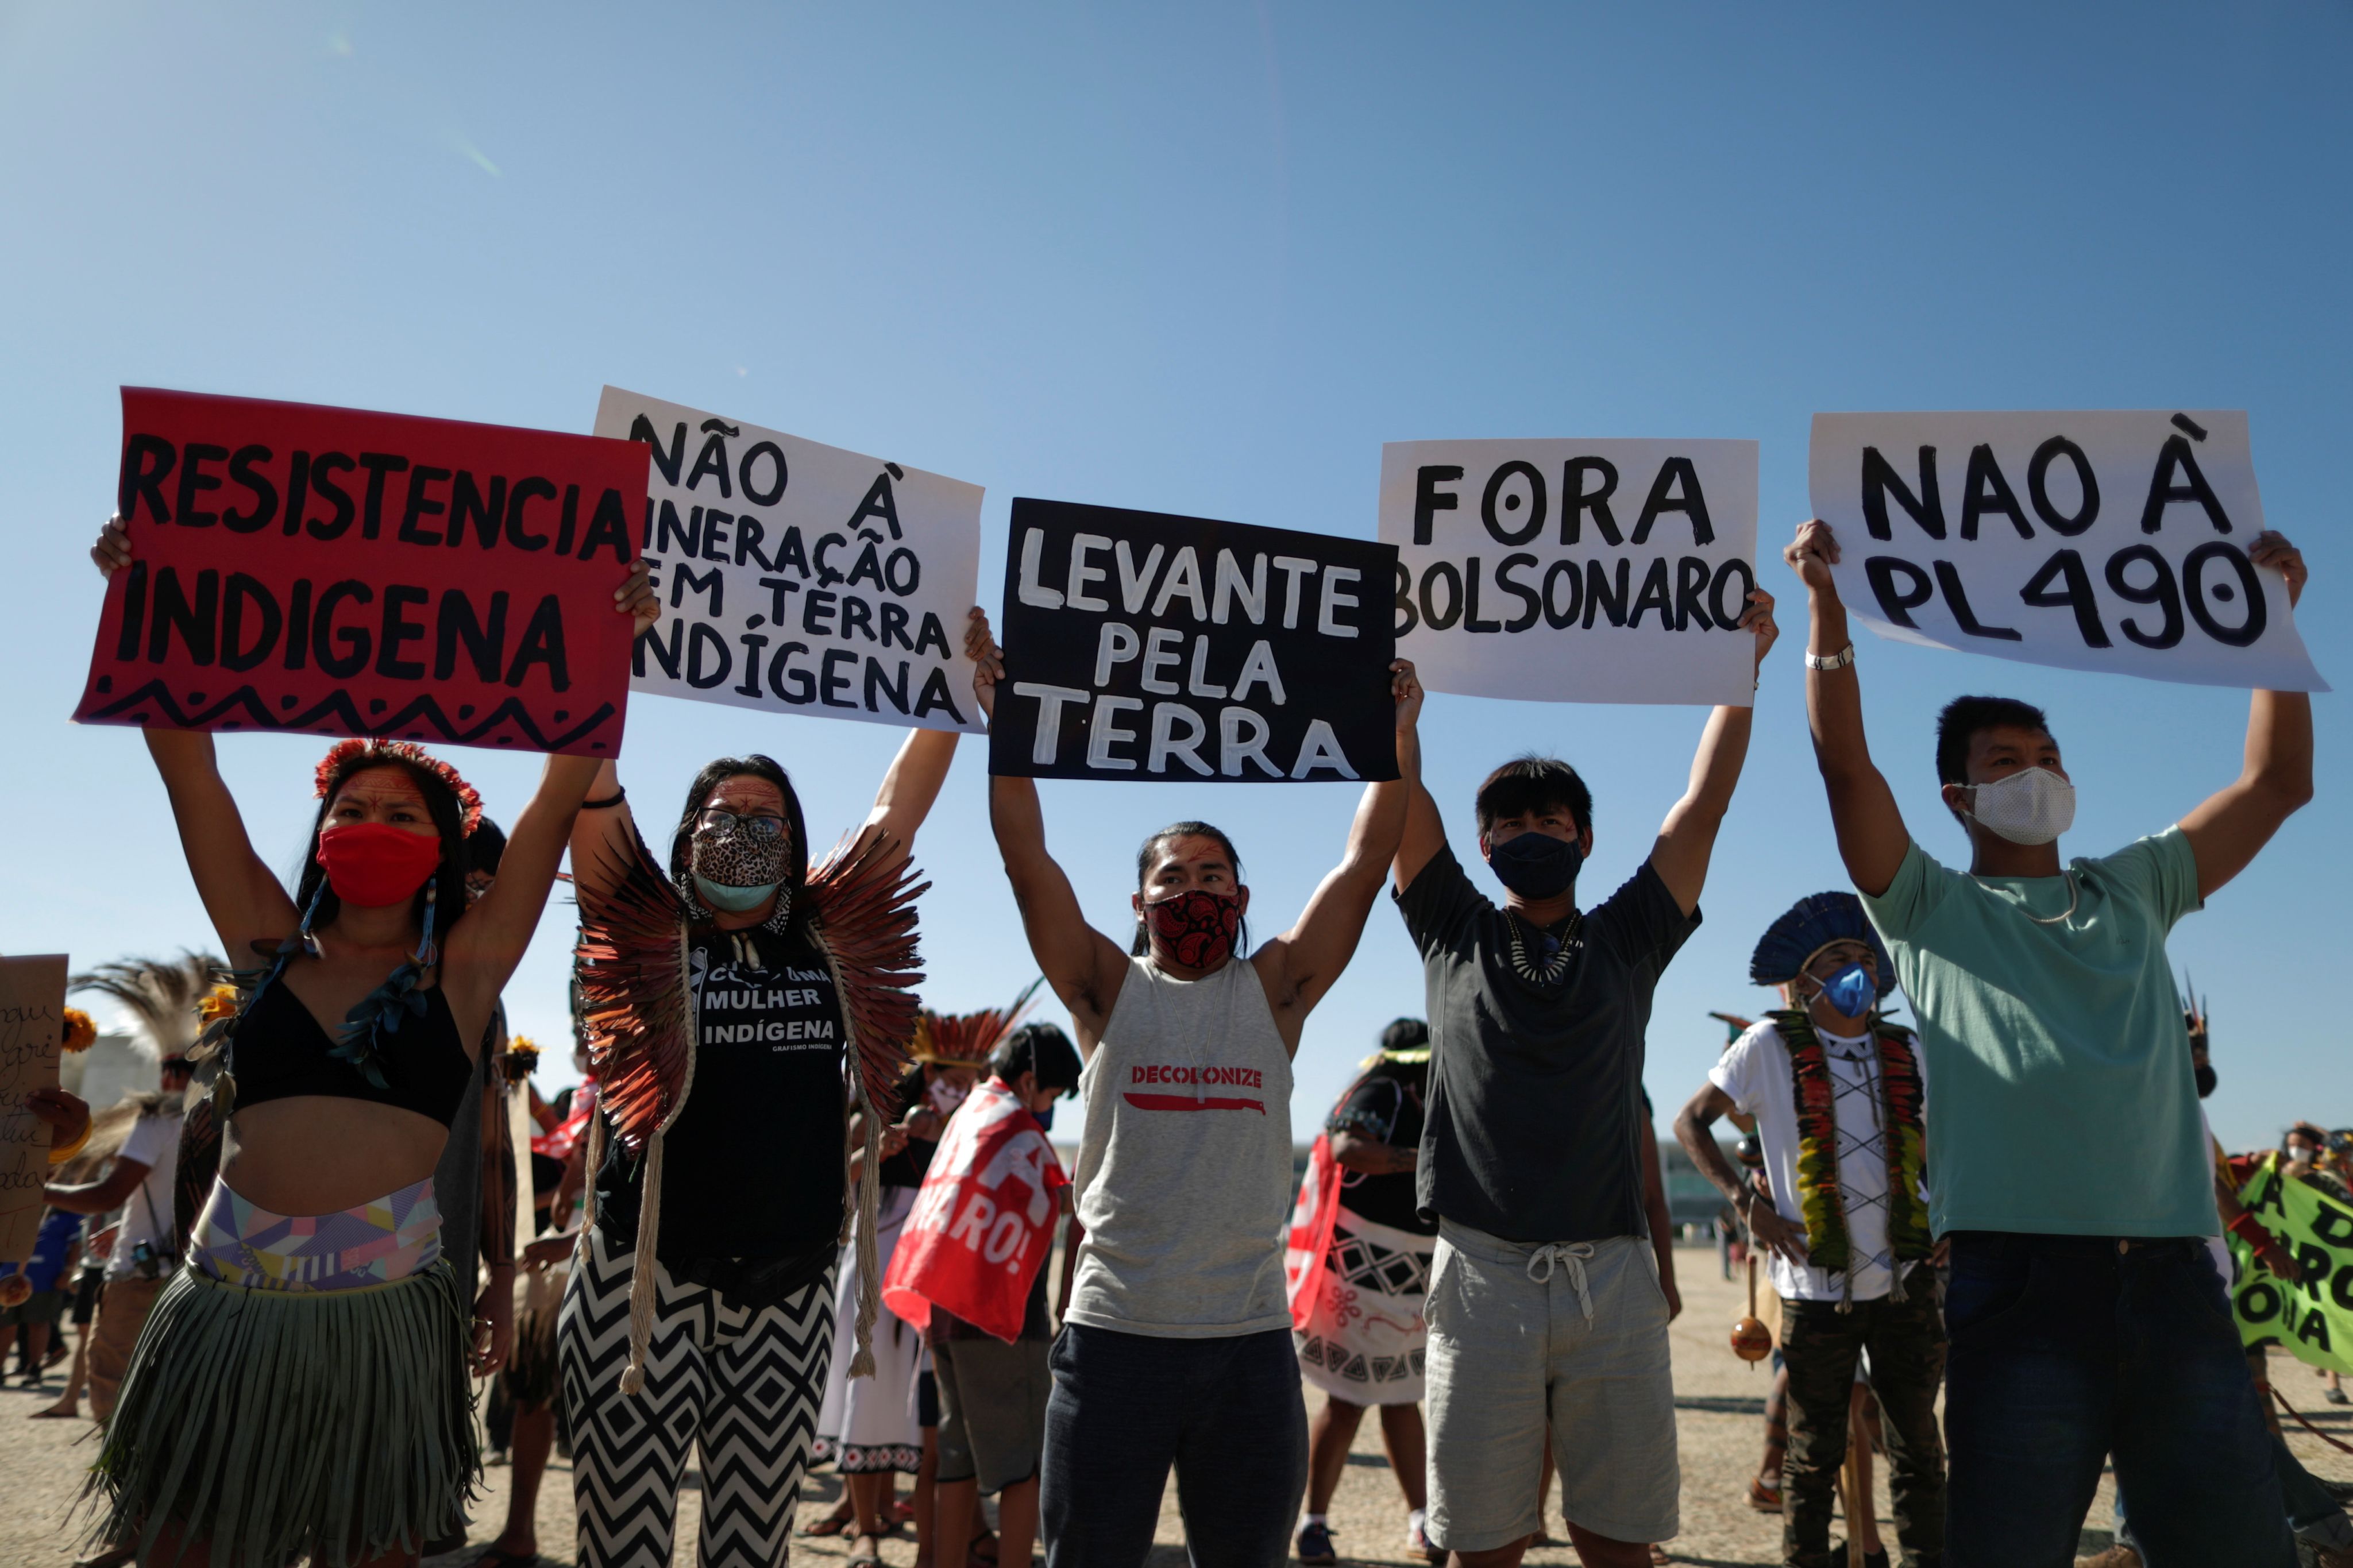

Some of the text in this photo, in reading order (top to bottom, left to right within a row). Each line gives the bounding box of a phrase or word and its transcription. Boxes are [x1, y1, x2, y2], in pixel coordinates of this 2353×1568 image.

[121, 433, 632, 565] RESISTENCIA
[629, 413, 788, 507] NÃO
[1413, 456, 1715, 546] FORA
[1861, 412, 2234, 541] NAO À
[642, 496, 920, 597] INERAÇÃO
[1018, 527, 1361, 638] LEVANTE
[115, 559, 571, 693] INDIGENA
[759, 577, 952, 661] TERRA
[1395, 553, 1756, 639] BOLSONARO
[1864, 540, 2267, 650] PL 490
[632, 613, 967, 725] NDÍGENA
[1094, 622, 1287, 706] PELA
[1013, 681, 1361, 780] TERRA
[704, 1019, 834, 1044] INDÍGENA
[705, 988, 822, 1010] MULHER
[772, 1044, 807, 1052] GRAFISMO
[1132, 1065, 1262, 1089] DECOLONIZE
